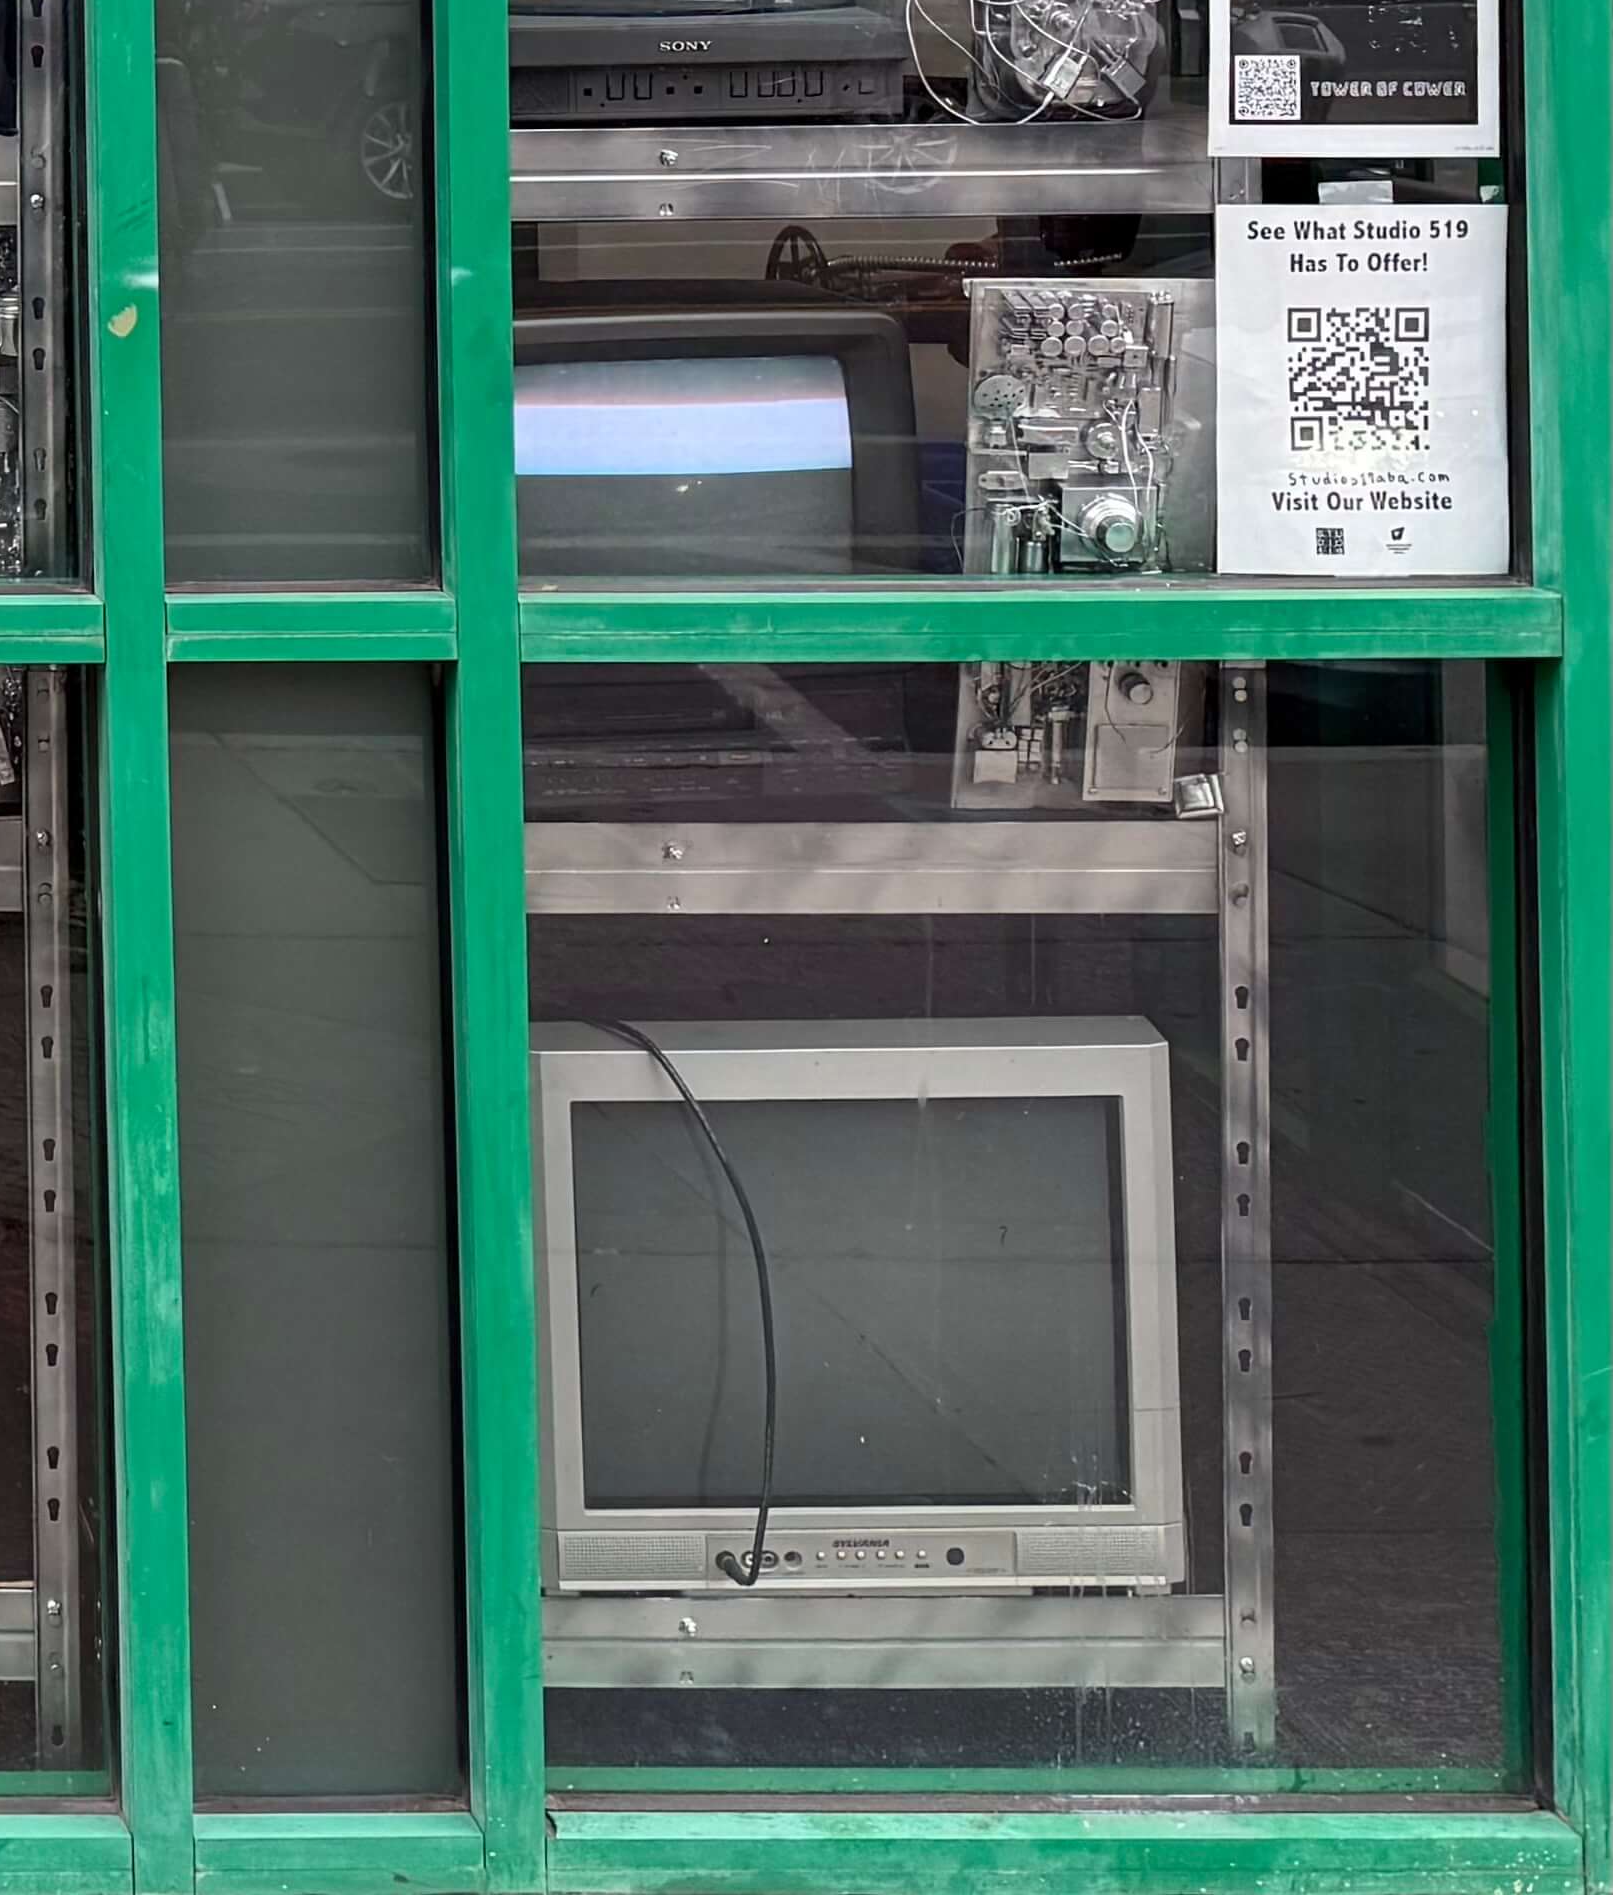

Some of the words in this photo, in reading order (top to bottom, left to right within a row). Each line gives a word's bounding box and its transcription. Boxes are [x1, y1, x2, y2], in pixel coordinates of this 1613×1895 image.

[659, 40, 712, 52] SONY
[1310, 80, 1373, 97] TOWER
[1376, 80, 1398, 97] OF
[1402, 80, 1466, 97] COWER
[1247, 220, 1286, 240] See
[1293, 220, 1346, 240] What
[1353, 219, 1421, 240] Studio
[1429, 219, 1469, 239] 519
[1290, 253, 1327, 273] Has
[1336, 253, 1359, 272] To
[1367, 252, 1428, 273] Offer!
[1272, 491, 1319, 511] Visit
[1327, 491, 1364, 511] Our
[1370, 490, 1453, 511] Website
